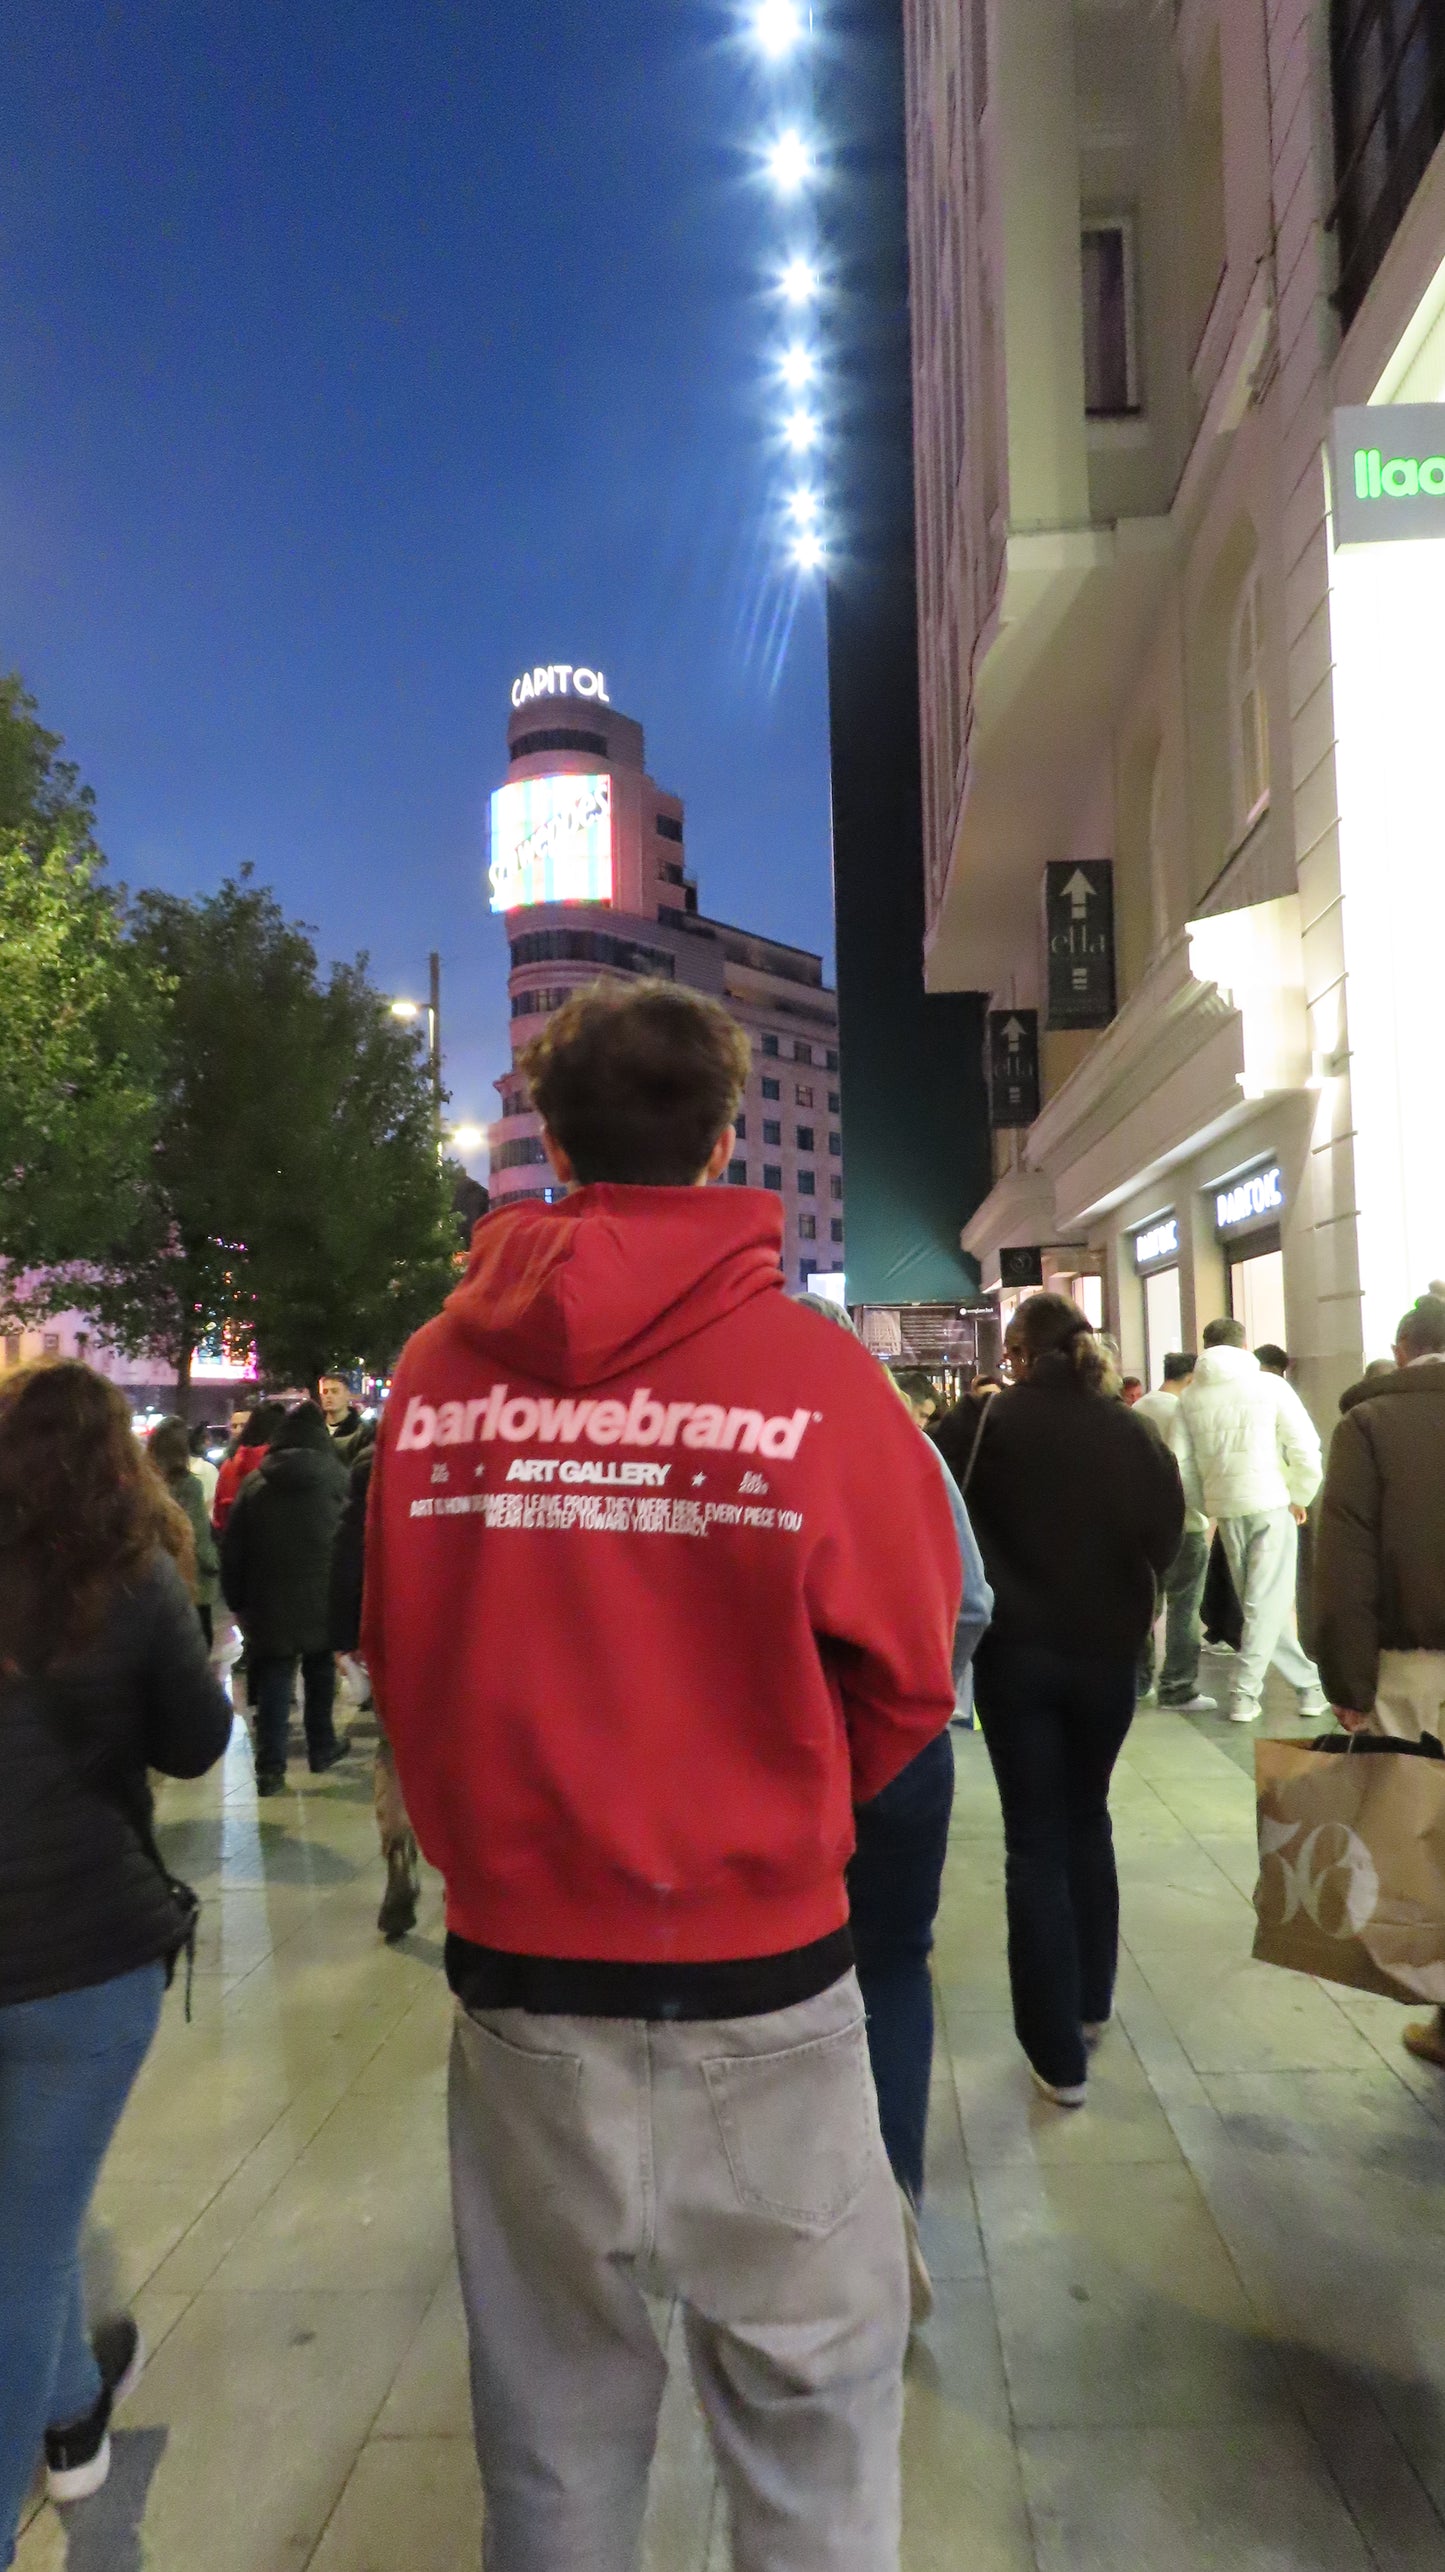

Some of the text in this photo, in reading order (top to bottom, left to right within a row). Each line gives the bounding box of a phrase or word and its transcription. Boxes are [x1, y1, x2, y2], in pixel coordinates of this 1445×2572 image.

[511, 664, 609, 707] CAPITOL
[396, 1384, 811, 1460] barlowebrand
[505, 1459, 672, 1486] ART GALLERY
[604, 1496, 636, 1515] THEY
[705, 1502, 743, 1525] EVERY
[743, 1506, 777, 1528] PIECE
[777, 1509, 803, 1533] YOU
